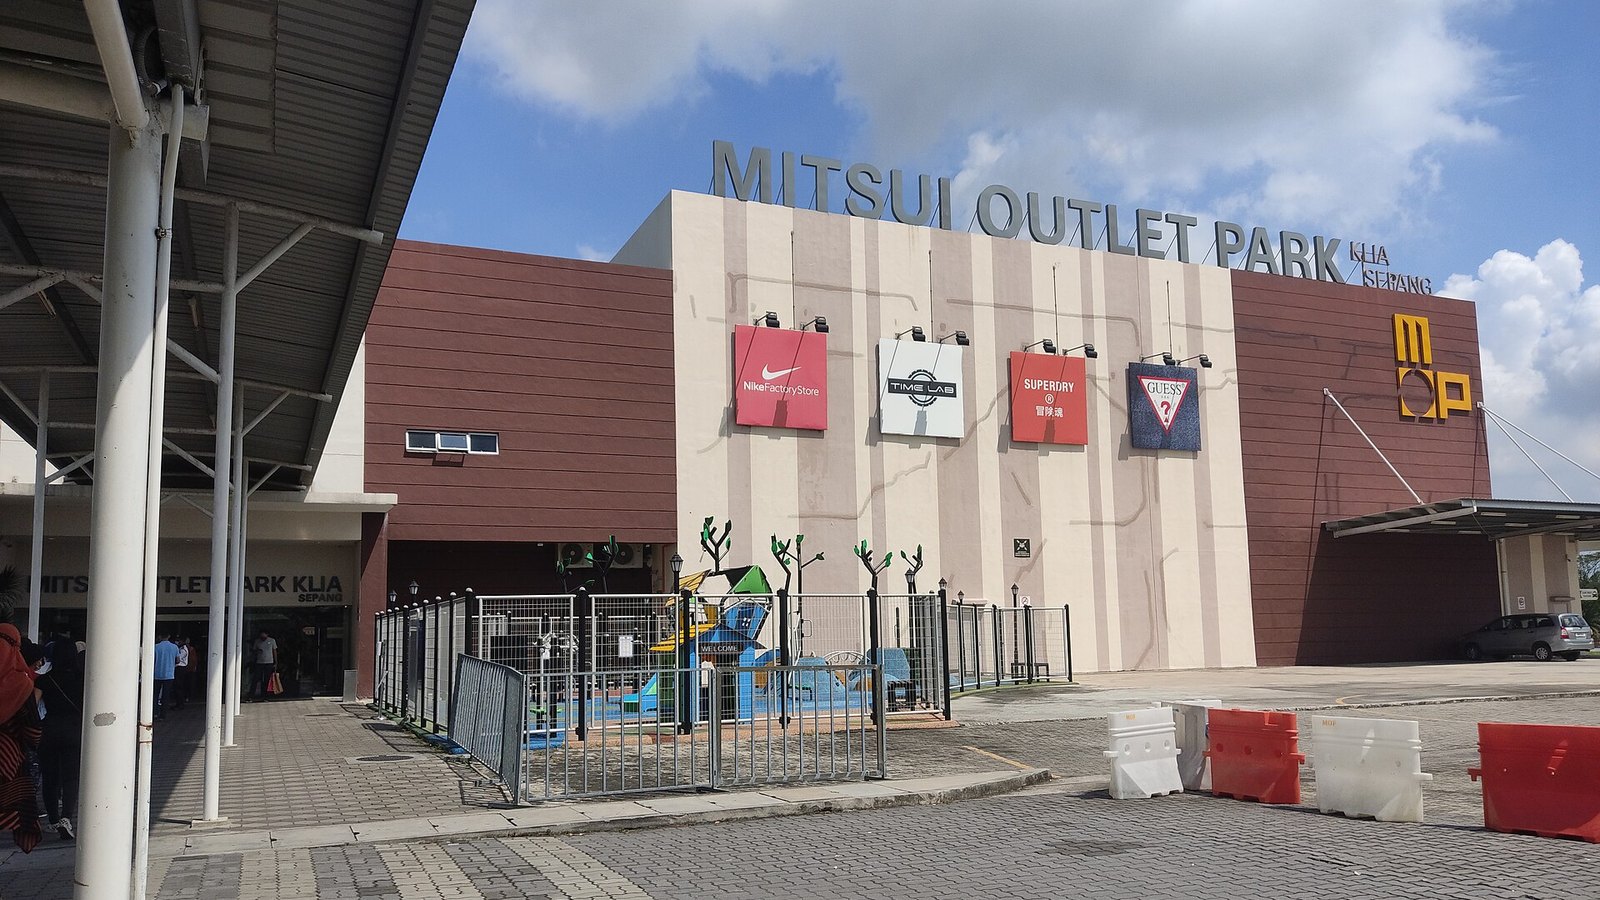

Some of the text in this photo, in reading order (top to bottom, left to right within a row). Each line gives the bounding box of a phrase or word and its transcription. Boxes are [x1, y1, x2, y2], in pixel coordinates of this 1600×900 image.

[712, 140, 1345, 284] MITSUI OUTLET PARK
[1364, 269, 1432, 295] SEPANG
[890, 382, 955, 394] TIME LAB
[1024, 378, 1075, 393] SUPERDRY
[293, 575, 343, 593] KLIA
[298, 593, 343, 603] SEPANG
